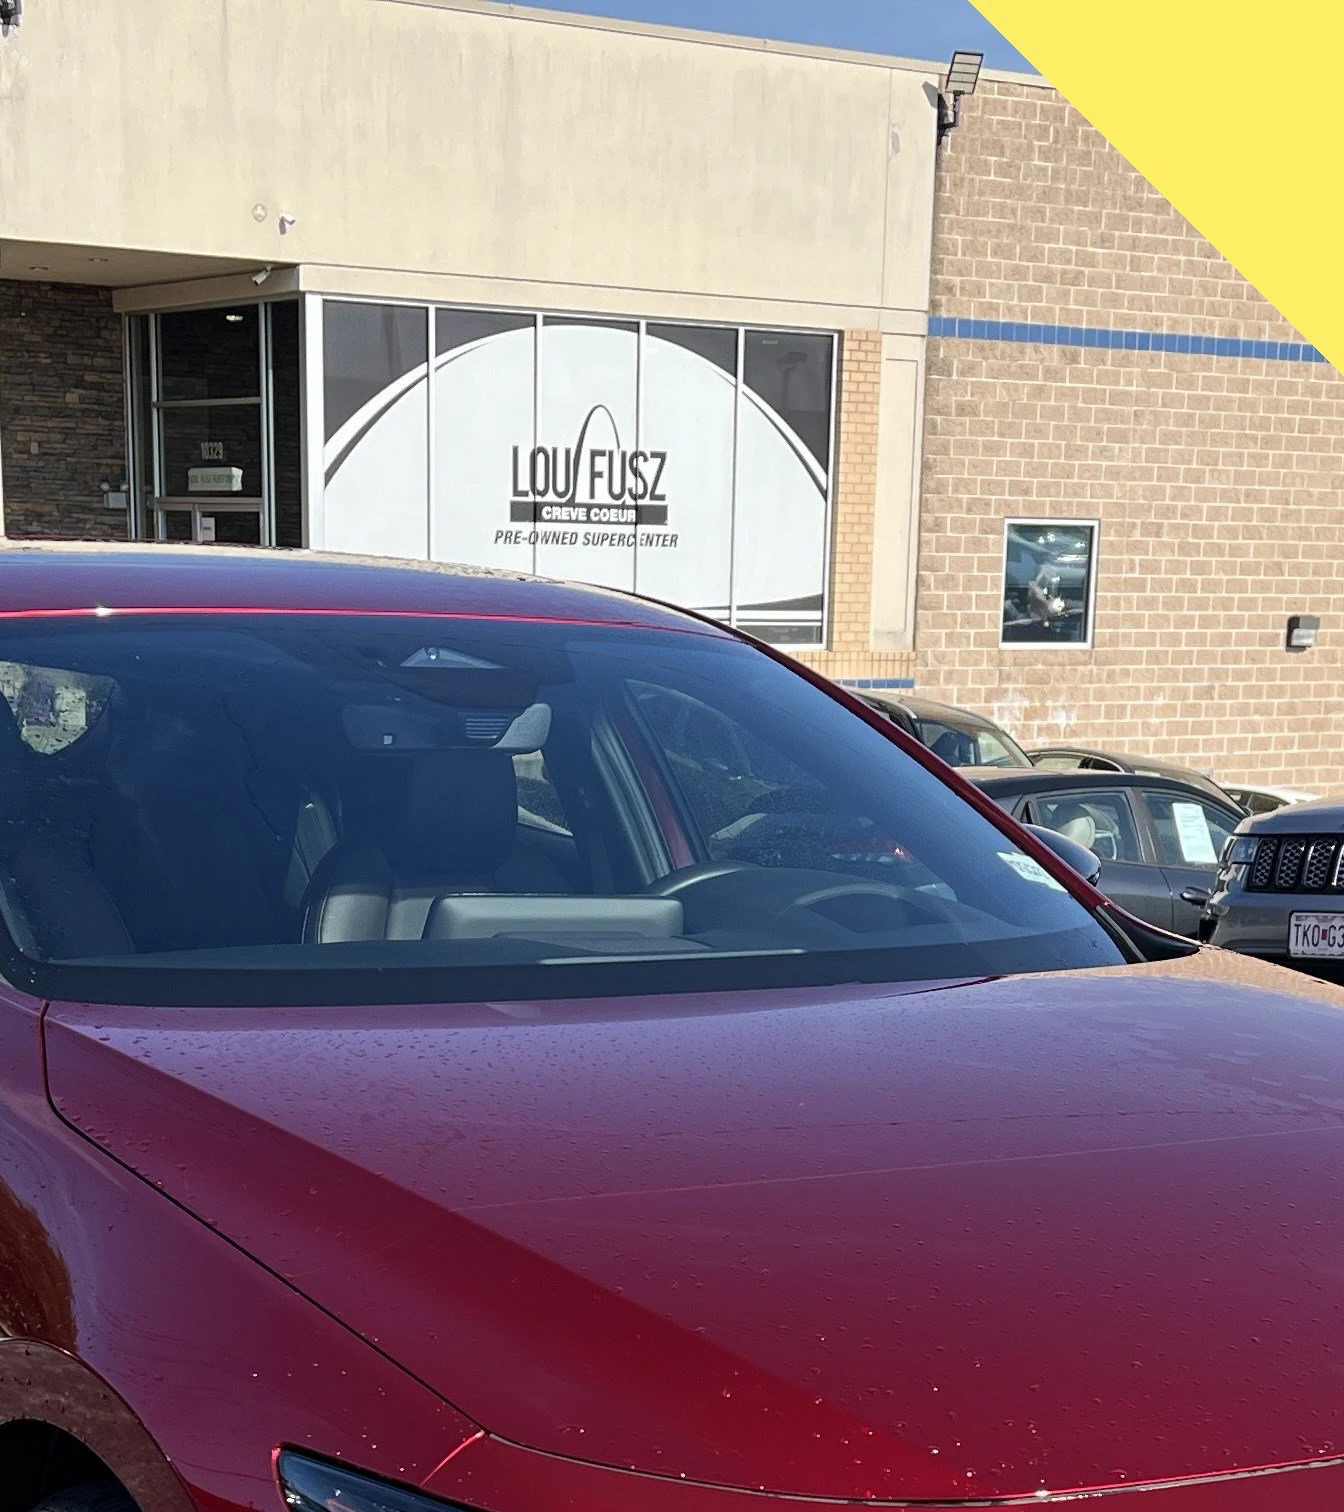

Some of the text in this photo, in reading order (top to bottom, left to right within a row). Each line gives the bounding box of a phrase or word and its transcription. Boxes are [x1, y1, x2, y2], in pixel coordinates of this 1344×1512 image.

[512, 445, 667, 502] LOU FUSZ
[541, 506, 636, 522] CREVE COEUR
[494, 529, 578, 546] PRE-OWNED
